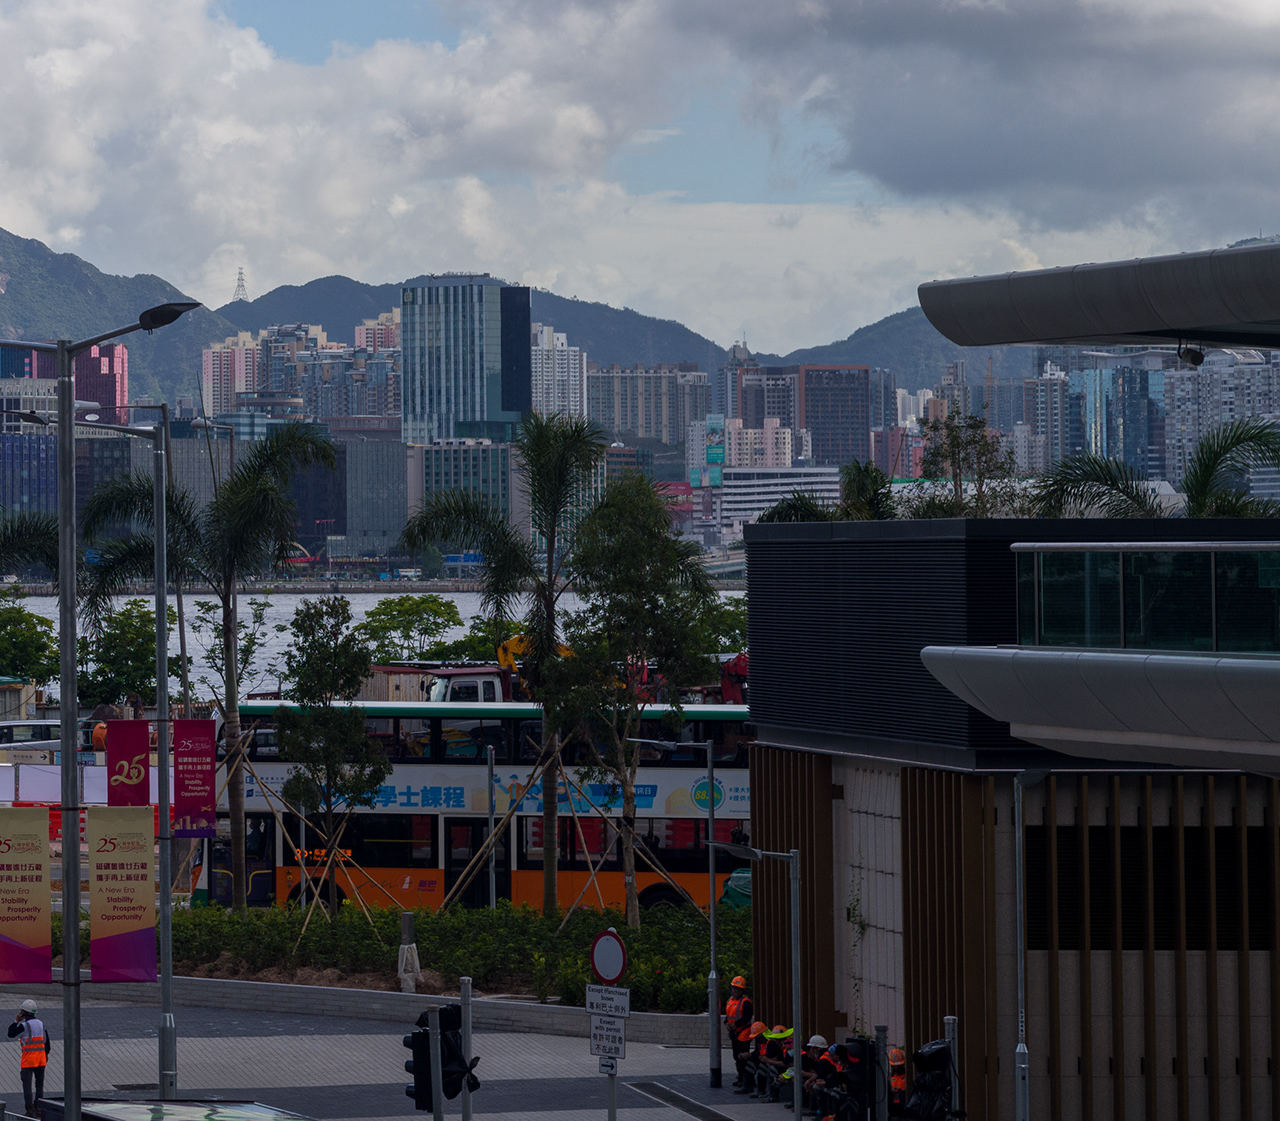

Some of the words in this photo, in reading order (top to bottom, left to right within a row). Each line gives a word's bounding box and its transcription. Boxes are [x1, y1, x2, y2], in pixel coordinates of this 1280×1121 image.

[178, 740, 193, 751] 25
[96, 838, 117, 853] 25
[106, 896, 134, 904] Stability
